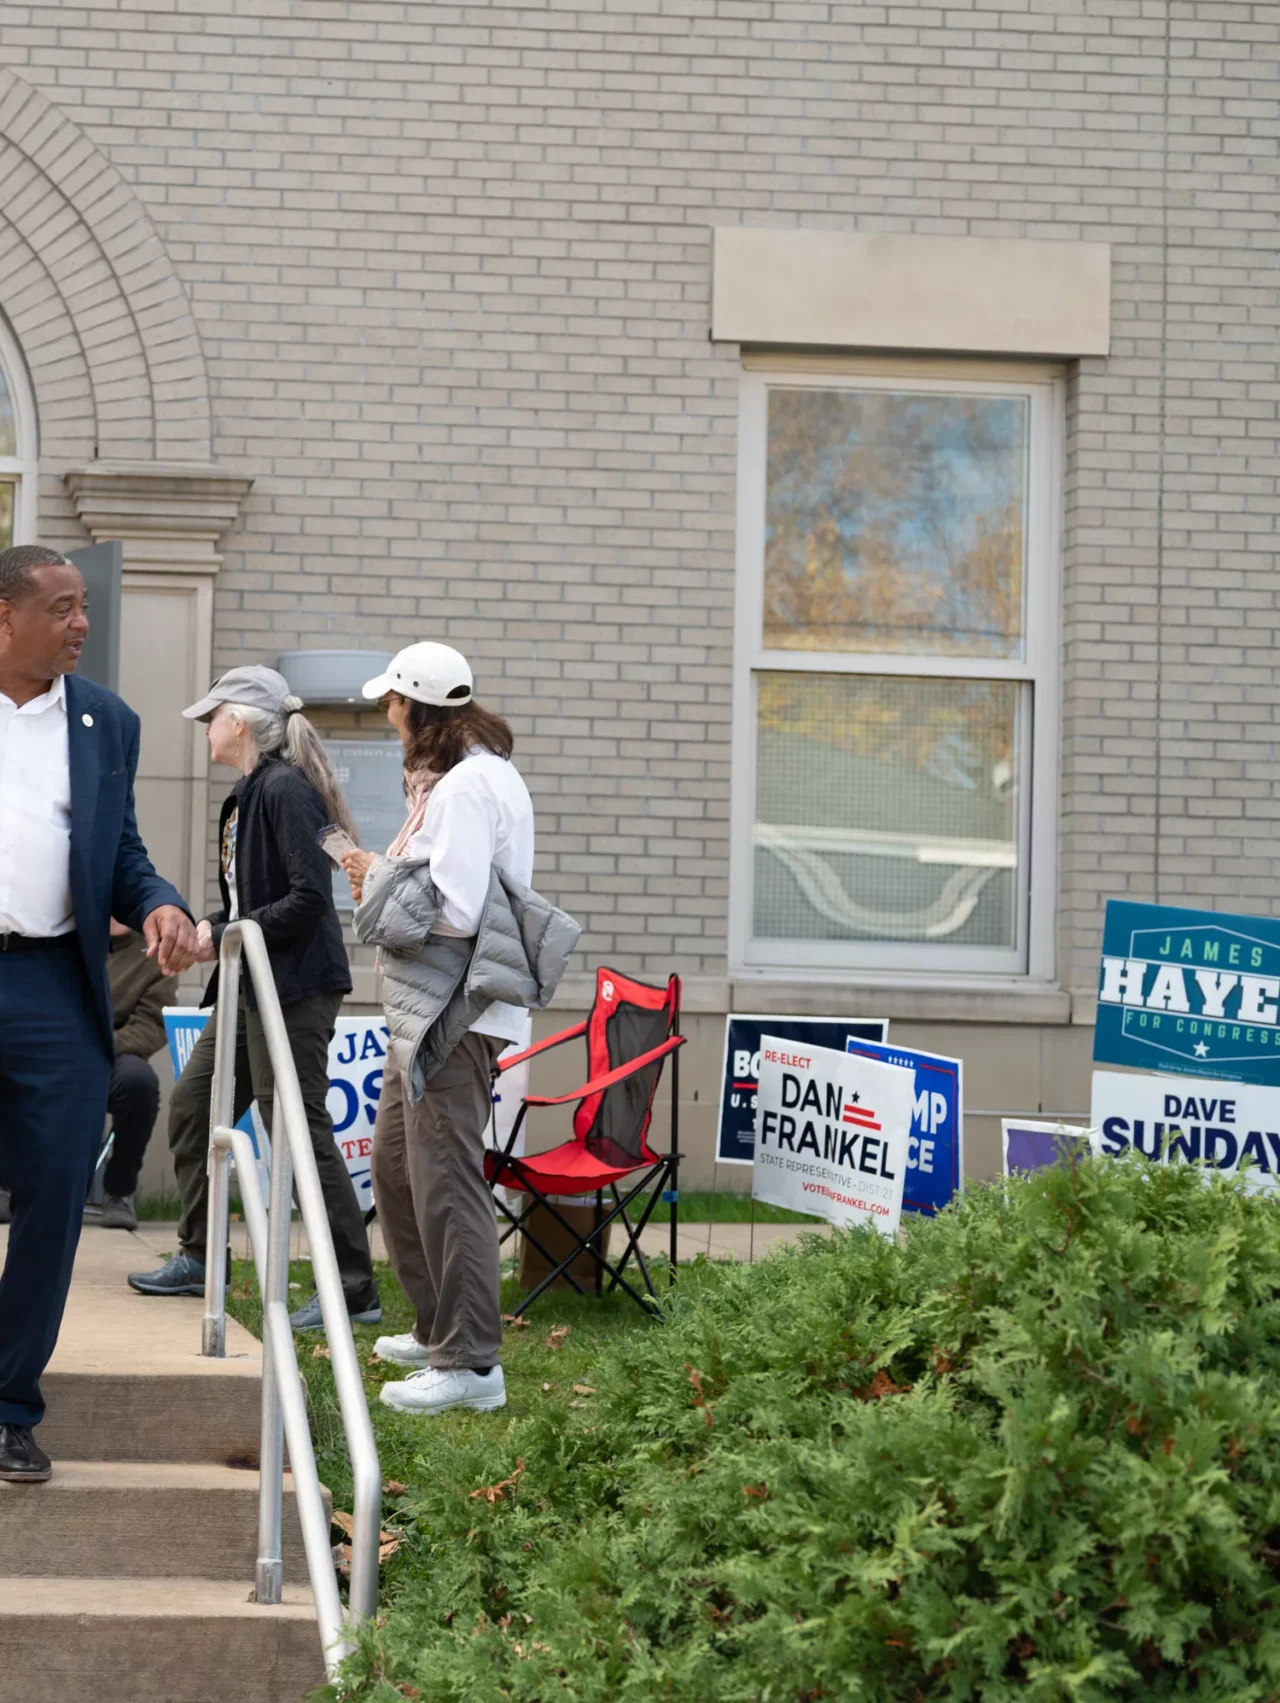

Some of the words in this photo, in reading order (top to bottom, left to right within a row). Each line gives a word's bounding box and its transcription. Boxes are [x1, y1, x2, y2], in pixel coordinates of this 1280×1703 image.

[1159, 936, 1262, 967] JAMES
[1100, 958, 1280, 1024] HAYE
[1126, 1011, 1161, 1029] FOR
[1176, 1019, 1280, 1045] CONGRESS
[764, 1050, 811, 1069] RE-ELECT
[781, 1073, 843, 1121] DAN
[1164, 1094, 1236, 1123] DAVE
[761, 1110, 895, 1180] FRANKEL
[760, 1153, 785, 1169] STATE
[786, 1159, 852, 1188] REPRESETIVE
[882, 1187, 893, 1200] 23
[802, 1181, 890, 1217] VOTEFRANKEL.COM
